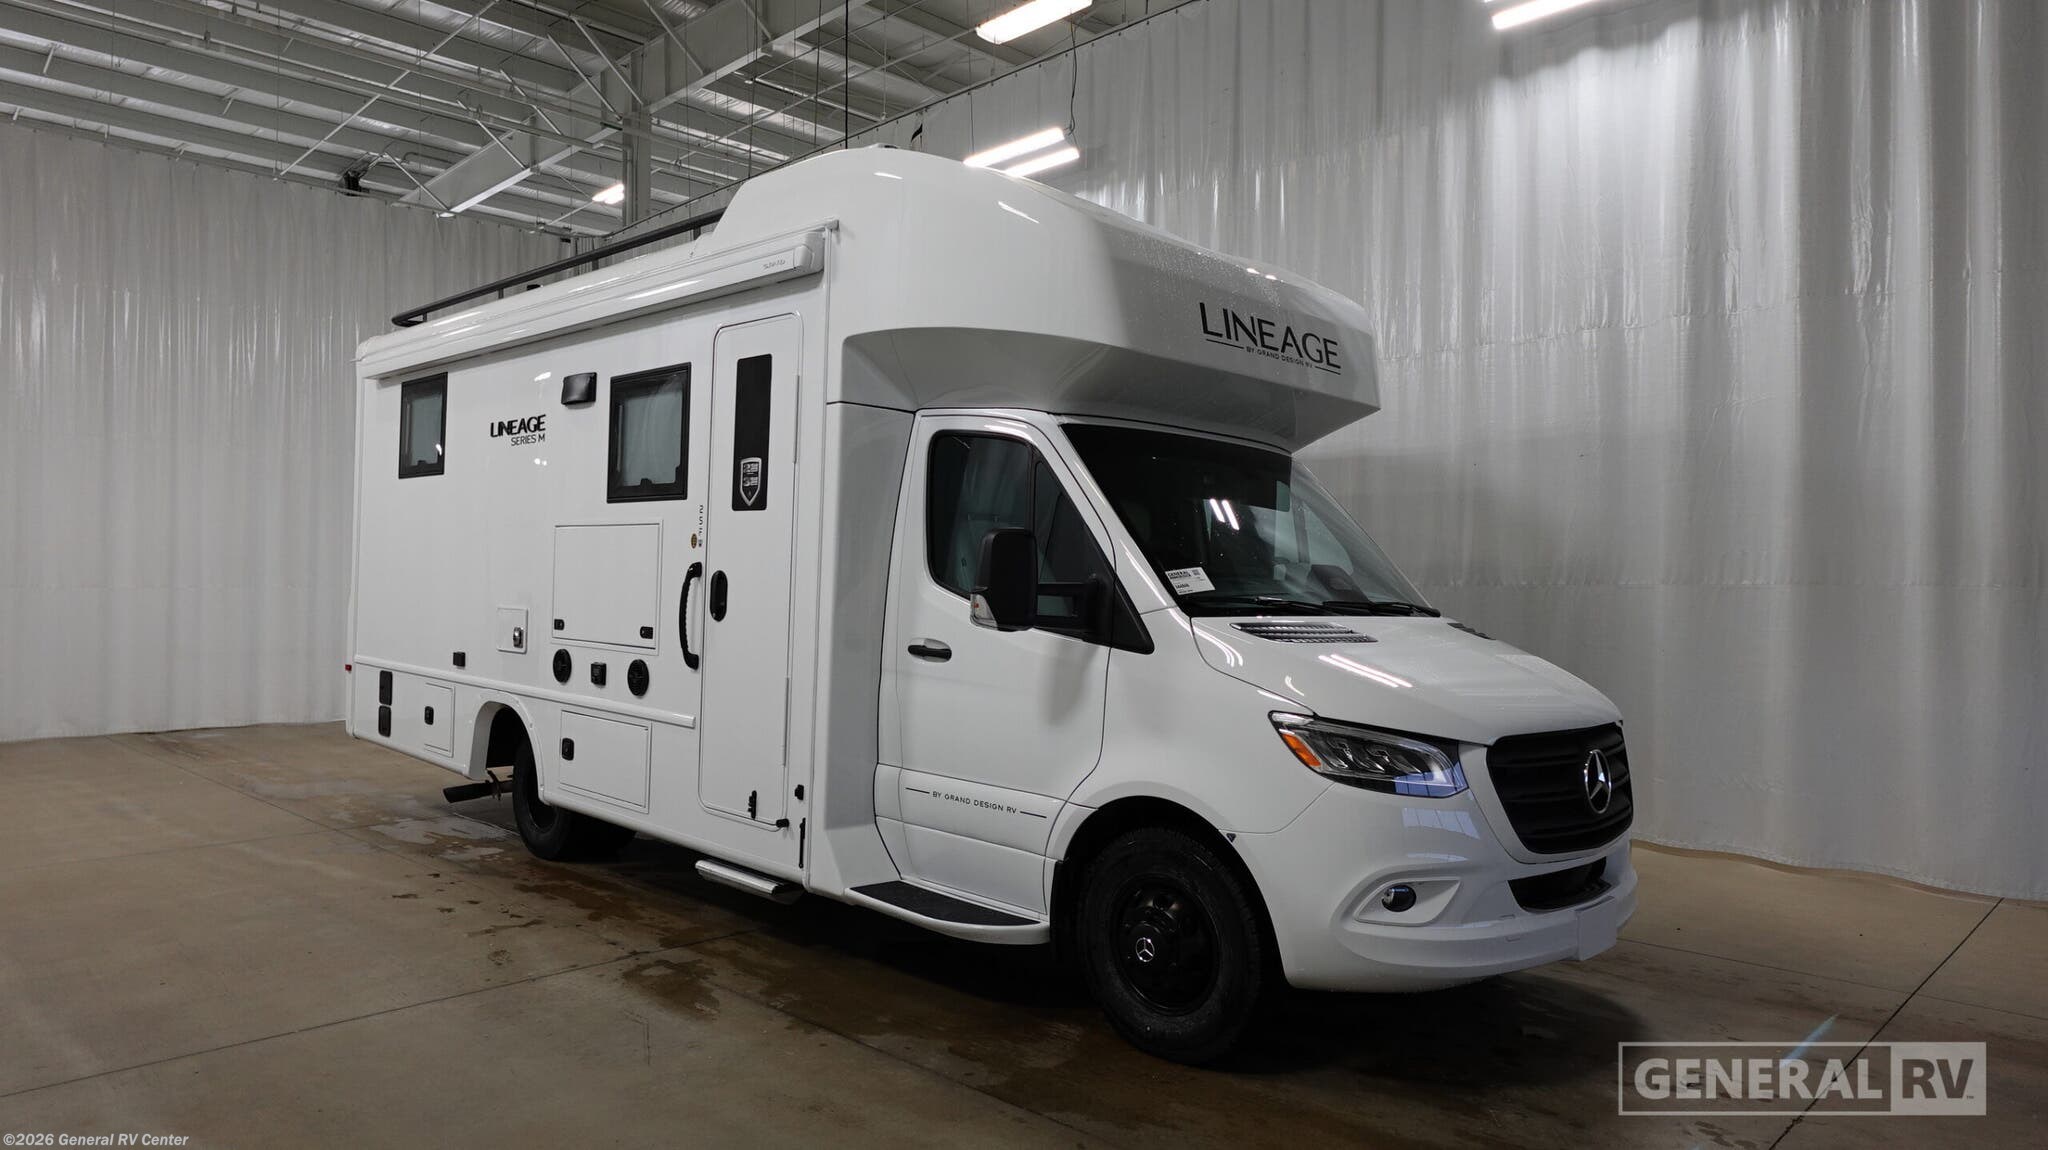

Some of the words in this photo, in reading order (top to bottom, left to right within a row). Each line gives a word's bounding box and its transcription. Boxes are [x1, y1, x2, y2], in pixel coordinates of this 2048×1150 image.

[1199, 302, 1341, 369] LINEAGE
[1257, 349, 1280, 360] GRAND
[1281, 355, 1304, 367] DESIGN
[490, 414, 547, 438] LINEAGE
[510, 434, 537, 447] SERIES
[537, 433, 546, 443] M
[932, 791, 942, 799] BY
[944, 793, 971, 805] GRAND
[973, 799, 1004, 812] DESIGN
[1006, 806, 1017, 815] RV
